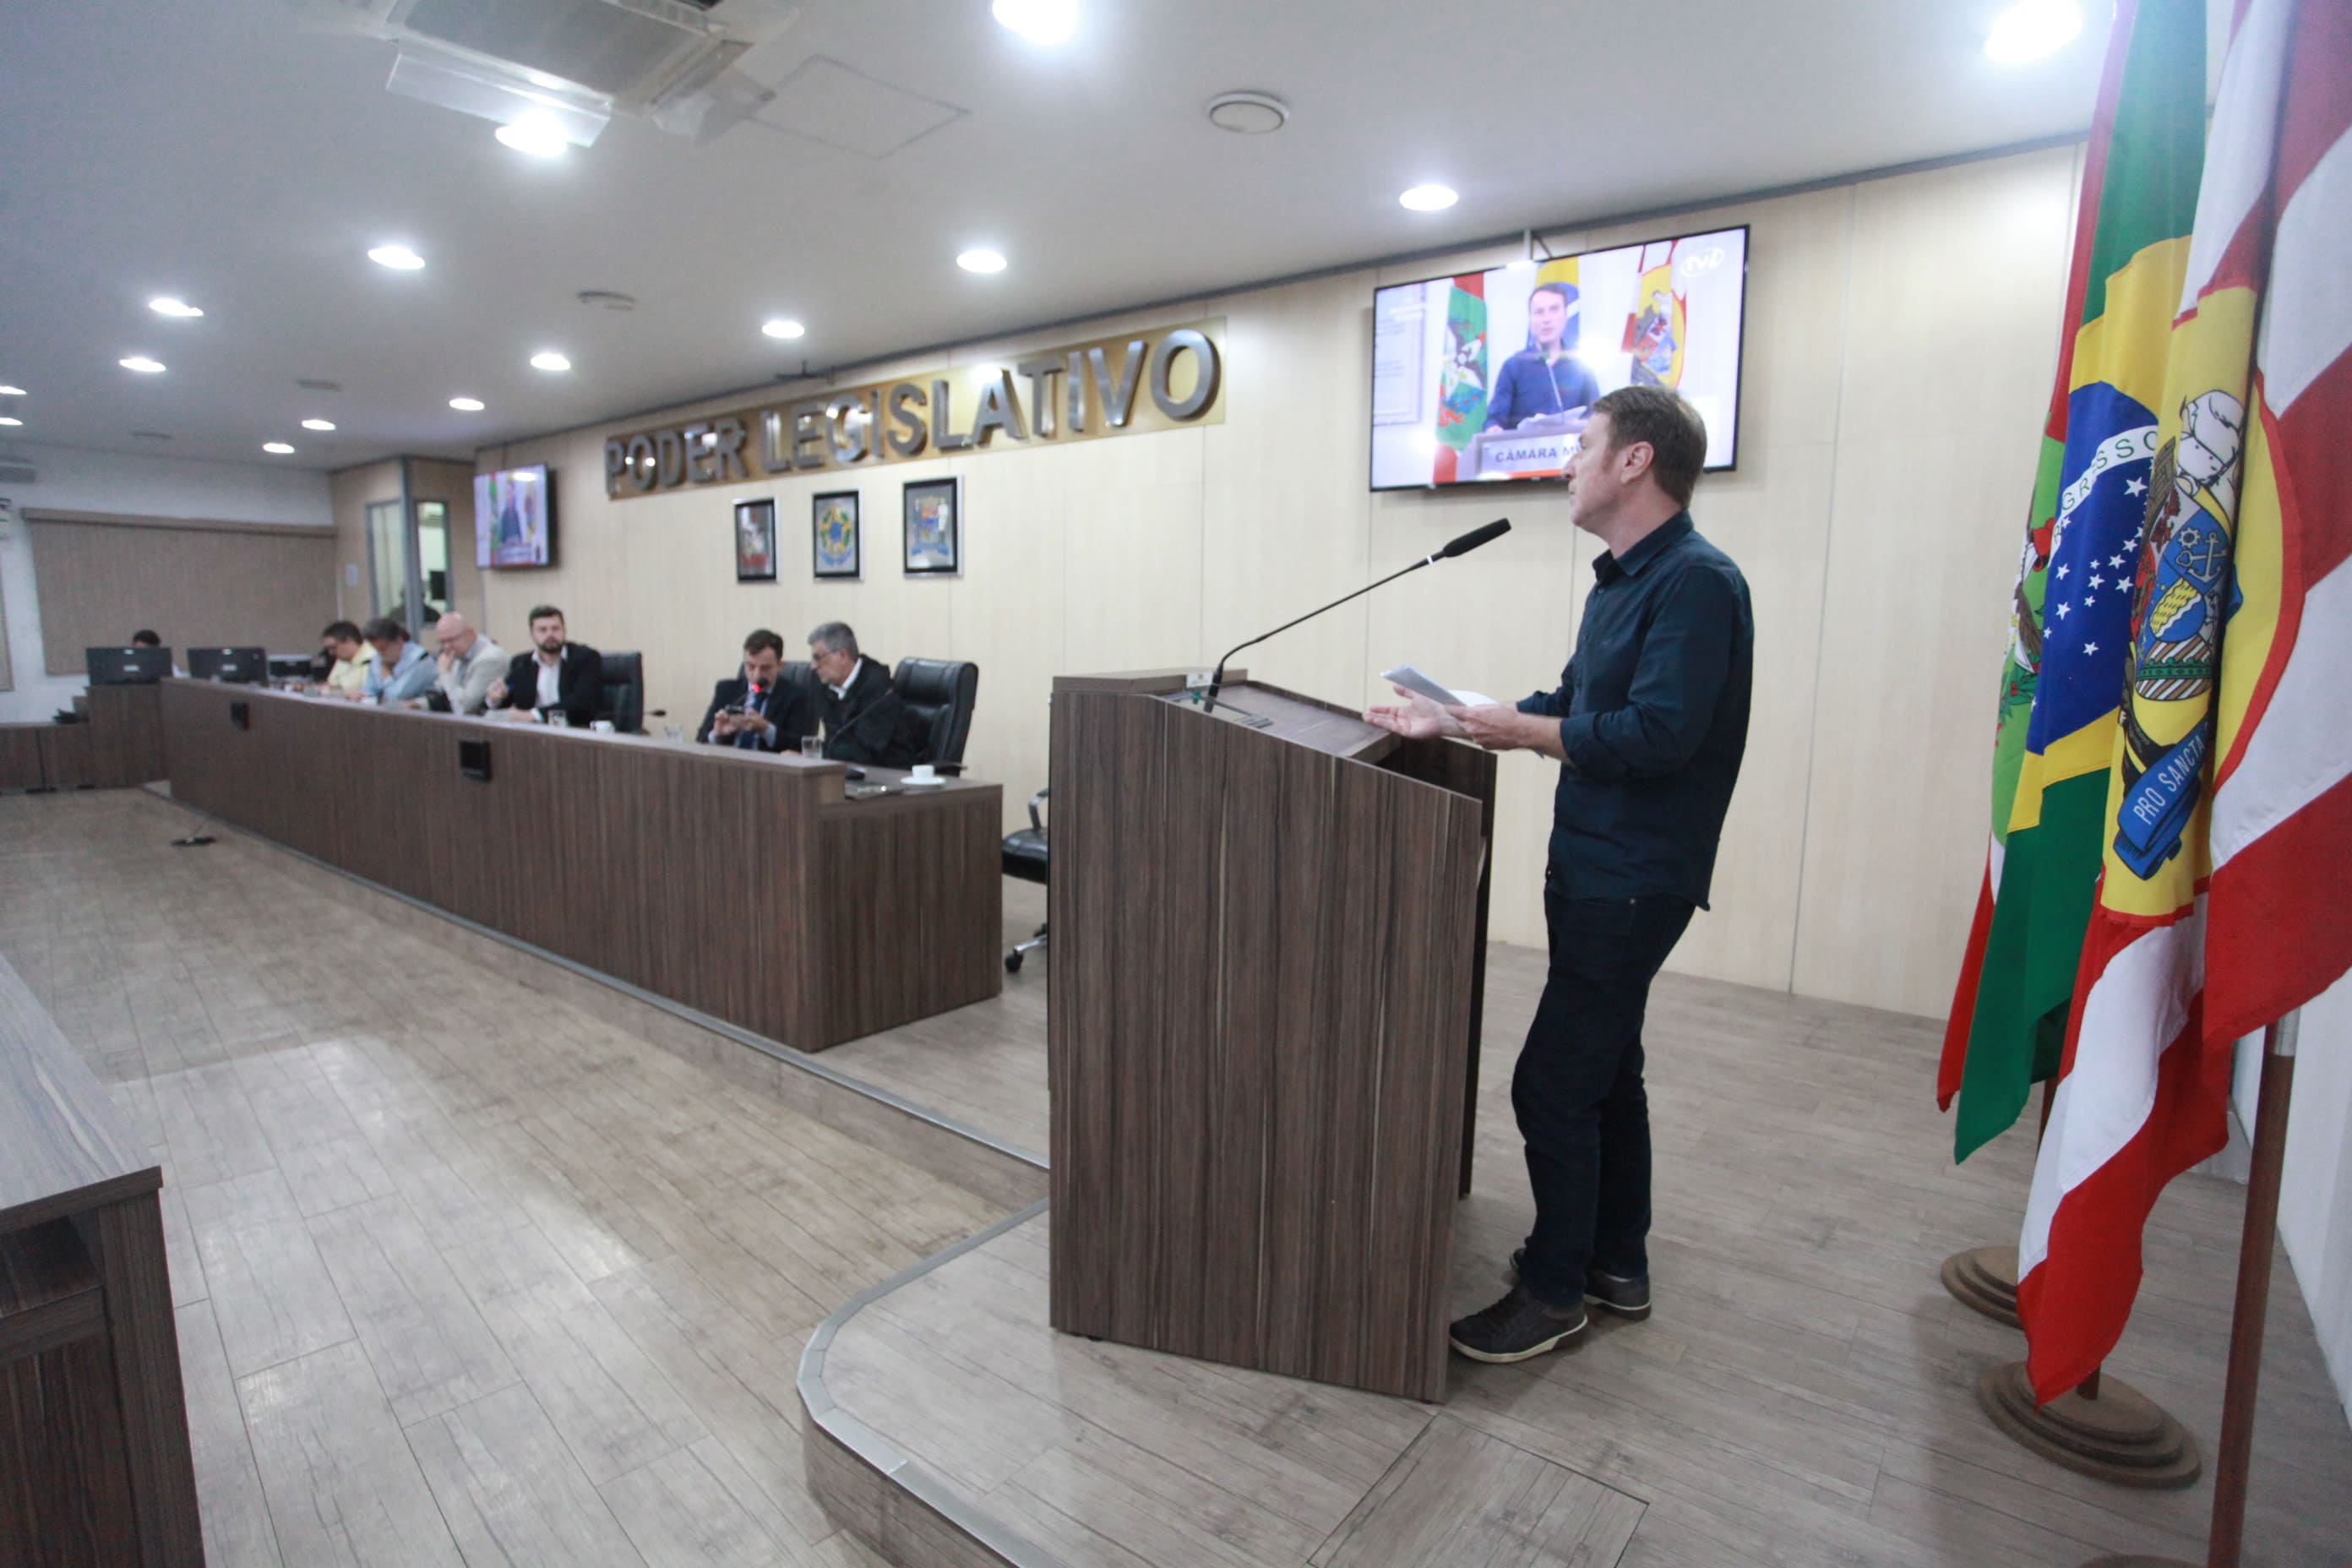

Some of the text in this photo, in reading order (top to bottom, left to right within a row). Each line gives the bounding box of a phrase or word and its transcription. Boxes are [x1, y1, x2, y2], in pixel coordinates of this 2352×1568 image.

[604, 329, 1222, 496] PODER LEGISLATIVO
[2132, 734, 2206, 825] PRO SANCTA
